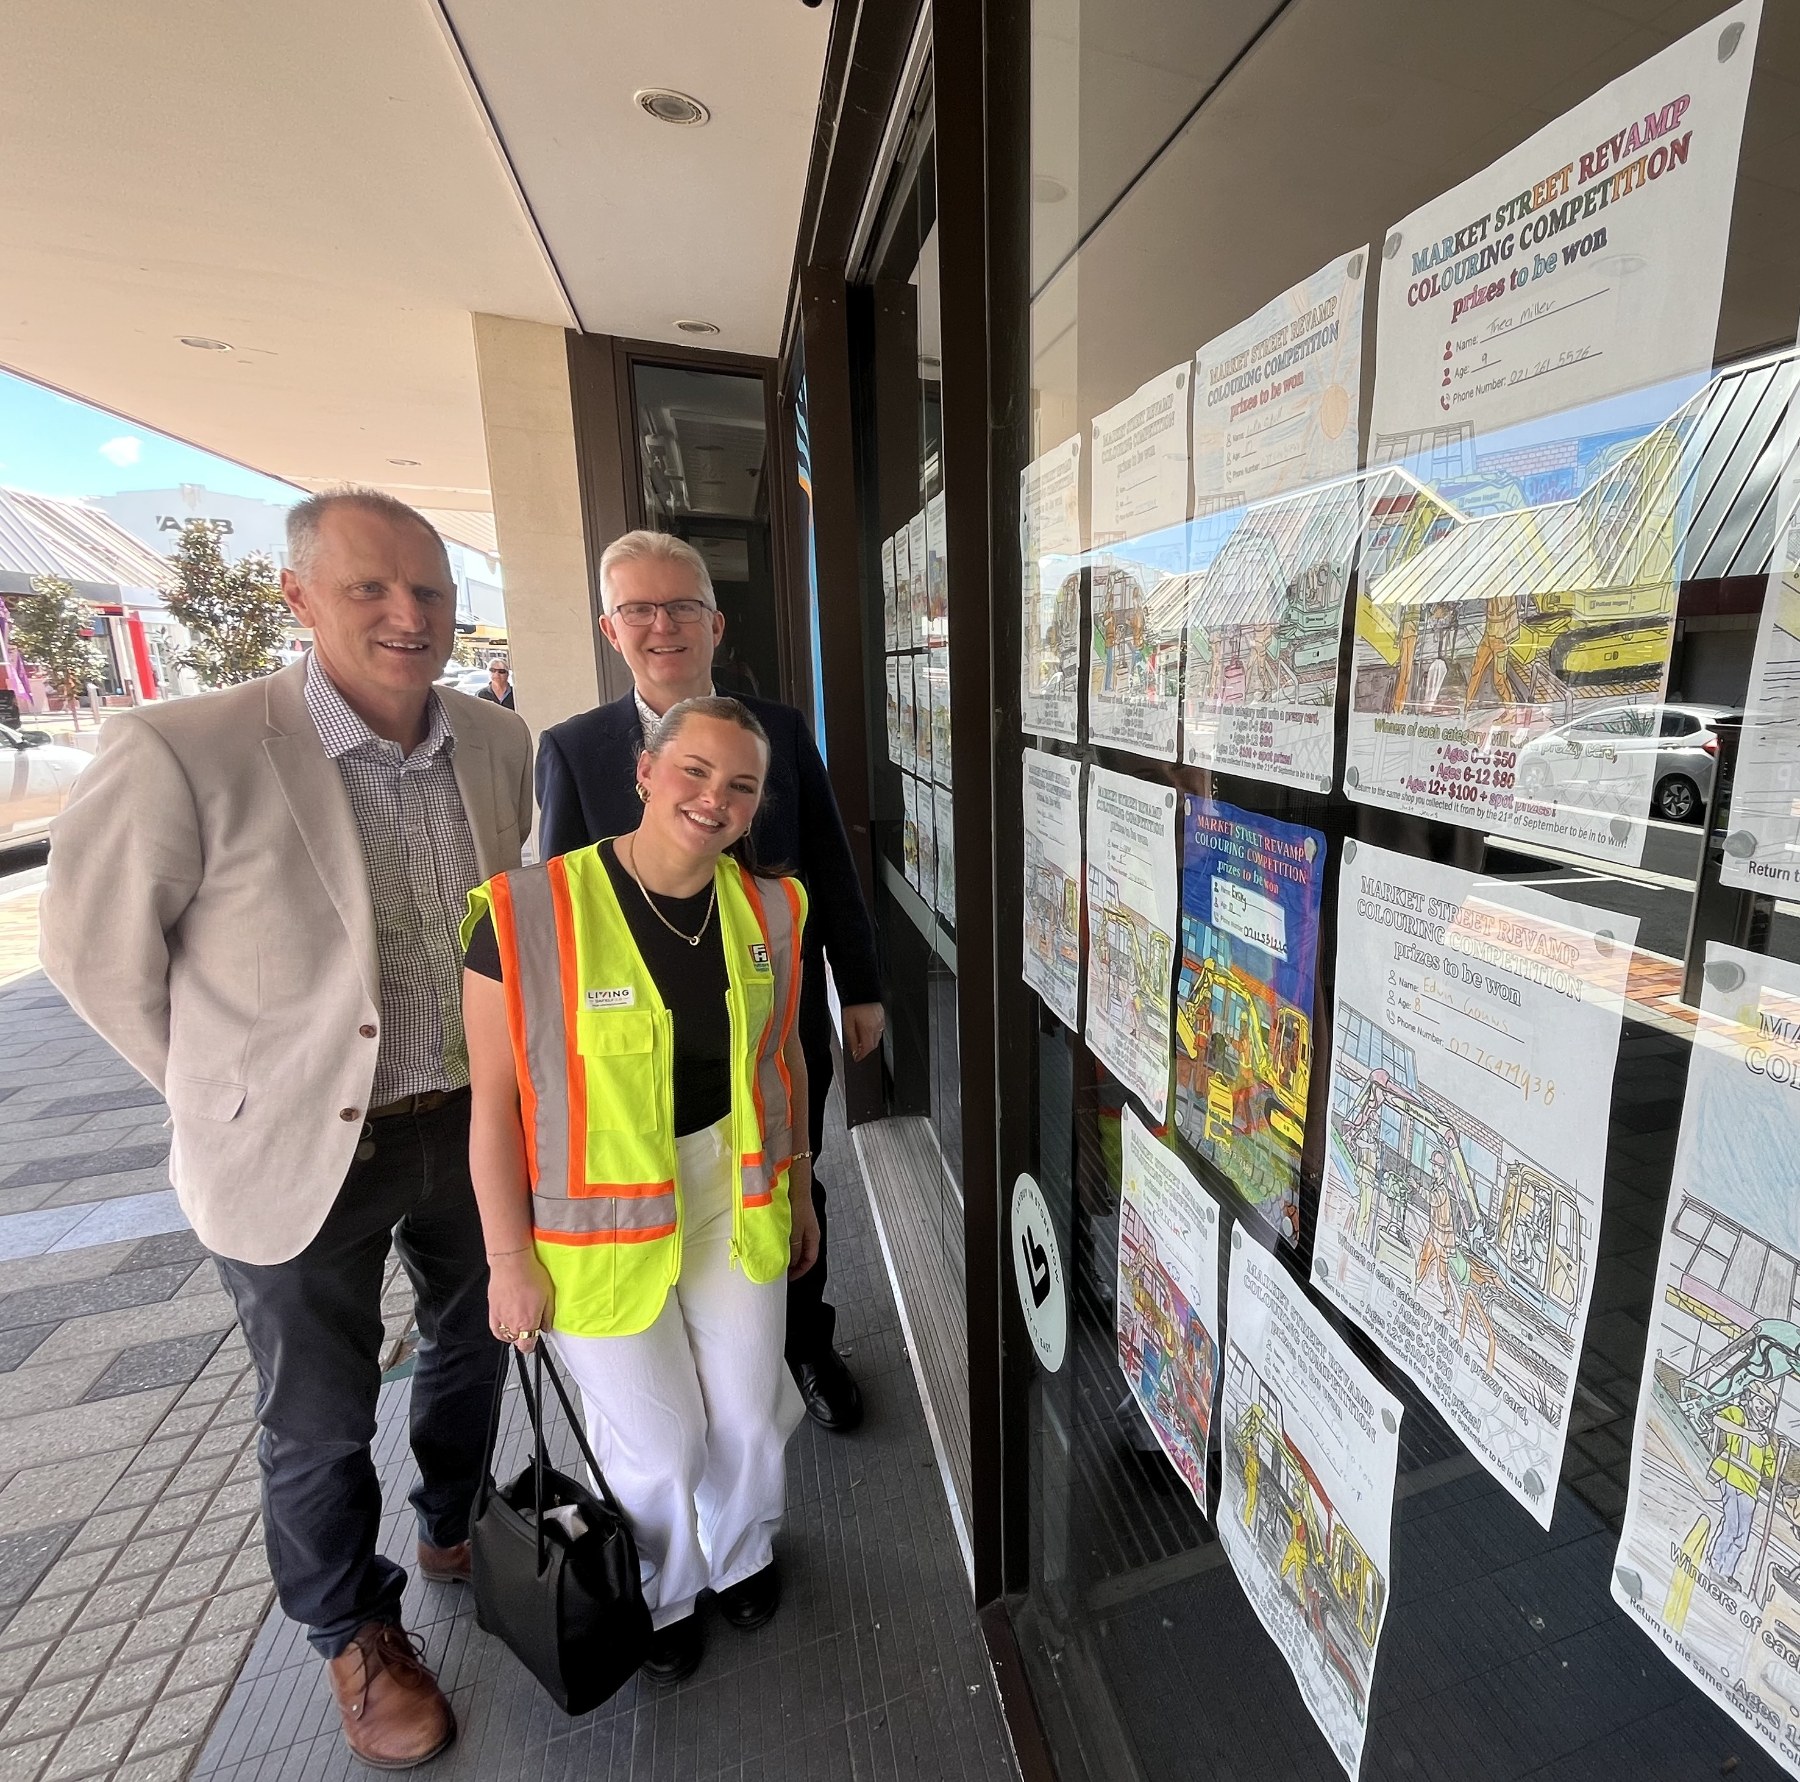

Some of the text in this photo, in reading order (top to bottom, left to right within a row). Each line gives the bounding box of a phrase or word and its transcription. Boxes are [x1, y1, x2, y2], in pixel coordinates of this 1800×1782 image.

[1412, 93, 1691, 276] MARKET STREET REVAMP
[1407, 130, 1693, 307] COLOURING COMPETITION
[1451, 227, 1608, 324] prizes to be won
[1519, 300, 1556, 324] Miller
[1207, 320, 1340, 408] COLOURING COMPETITION
[1209, 295, 1338, 387] MARKET STREET REVAMP
[1456, 335, 1479, 352] Name:
[1229, 394, 1258, 422] prizes
[1259, 388, 1270, 405] to
[1270, 382, 1282, 400] be
[1283, 370, 1304, 393] won
[1452, 377, 1506, 404] Phone Number:
[1454, 365, 1470, 379] Age:
[1374, 718, 1407, 736] Winners
[1407, 722, 1419, 737] of
[1419, 724, 1440, 739] each
[1442, 727, 1486, 748] category
[1443, 744, 1516, 769] Ages $50
[1405, 774, 1427, 794] Ages
[1428, 779, 1447, 796] 12+
[1448, 781, 1478, 802] $100
[1479, 791, 1487, 801] +
[1489, 792, 1514, 810] spot
[1436, 762, 1516, 789] Ages 6-12 $80
[1197, 815, 1235, 837] MARKET
[1264, 836, 1305, 863] REVAMP
[1371, 786, 1377, 794] to
[1377, 787, 1386, 797] the
[1386, 790, 1401, 800] same
[1401, 791, 1415, 804] shop
[1415, 796, 1426, 805] you
[1426, 796, 1453, 811] collected
[1453, 803, 1460, 812] it
[1460, 804, 1476, 816] from
[1476, 805, 1486, 817] by
[1486, 808, 1498, 820] the
[1513, 815, 1522, 826] of
[1522, 816, 1569, 834] September
[1569, 826, 1577, 837] to
[1578, 828, 1588, 839] be
[1589, 829, 1596, 841] in
[1599, 833, 1606, 843] to
[1195, 831, 1307, 885] COLOURING COMPETITION
[1217, 860, 1241, 878] prizes
[1242, 868, 1252, 882] to
[1263, 878, 1279, 894] won
[1748, 860, 1790, 880] Return
[1357, 898, 1446, 946] COLOURING
[1449, 931, 1583, 1002] COMPETITION
[1361, 875, 1580, 969] MARKET STREET REVAMP
[1394, 941, 1522, 1007] prizes to be won
[1399, 976, 1419, 992] Name:
[1396, 1015, 1444, 1047] Phone Number:
[1397, 997, 1411, 1010] Age:
[1413, 997, 1421, 1011] 8
[1246, 1259, 1290, 1311] MARKET
[1290, 1304, 1327, 1360] STREET
[1328, 1351, 1375, 1420] REVAMP
[1338, 1231, 1529, 1426] Winners of each category will win a prezzy card,
[1393, 1315, 1453, 1382] Ages 6-12 $80
[1399, 1304, 1454, 1365] Ages $50
[1243, 1274, 1300, 1346] COLOURING
[1301, 1339, 1377, 1444] COMPETITION
[1270, 1320, 1297, 1360] prizes
[1298, 1354, 1308, 1374] to
[1308, 1365, 1322, 1391] be
[1322, 1386, 1343, 1421] won
[1365, 1304, 1385, 1329] Ages
[1387, 1322, 1403, 1343] 12+
[1404, 1339, 1428, 1368] $100
[1434, 1372, 1452, 1399] spot
[1451, 1393, 1481, 1433] prizes!
[1349, 1303, 1362, 1318] same
[1362, 1315, 1374, 1330] shop
[1374, 1327, 1384, 1339] you
[1384, 1336, 1409, 1362] collected
[1413, 1362, 1426, 1378] from
[1425, 1375, 1433, 1388] by
[1432, 1384, 1440, 1397] the
[1451, 1408, 1458, 1417] of
[1456, 1415, 1489, 1455] September
[1489, 1450, 1496, 1462] to
[1497, 1457, 1506, 1472] be
[1507, 1466, 1514, 1481] in
[1515, 1475, 1522, 1489] to
[1670, 1541, 1738, 1616] Winners
[1740, 1610, 1762, 1635] of
[1630, 1596, 1777, 1744] Return to the same shop you
[1734, 1678, 1781, 1730] Ages
